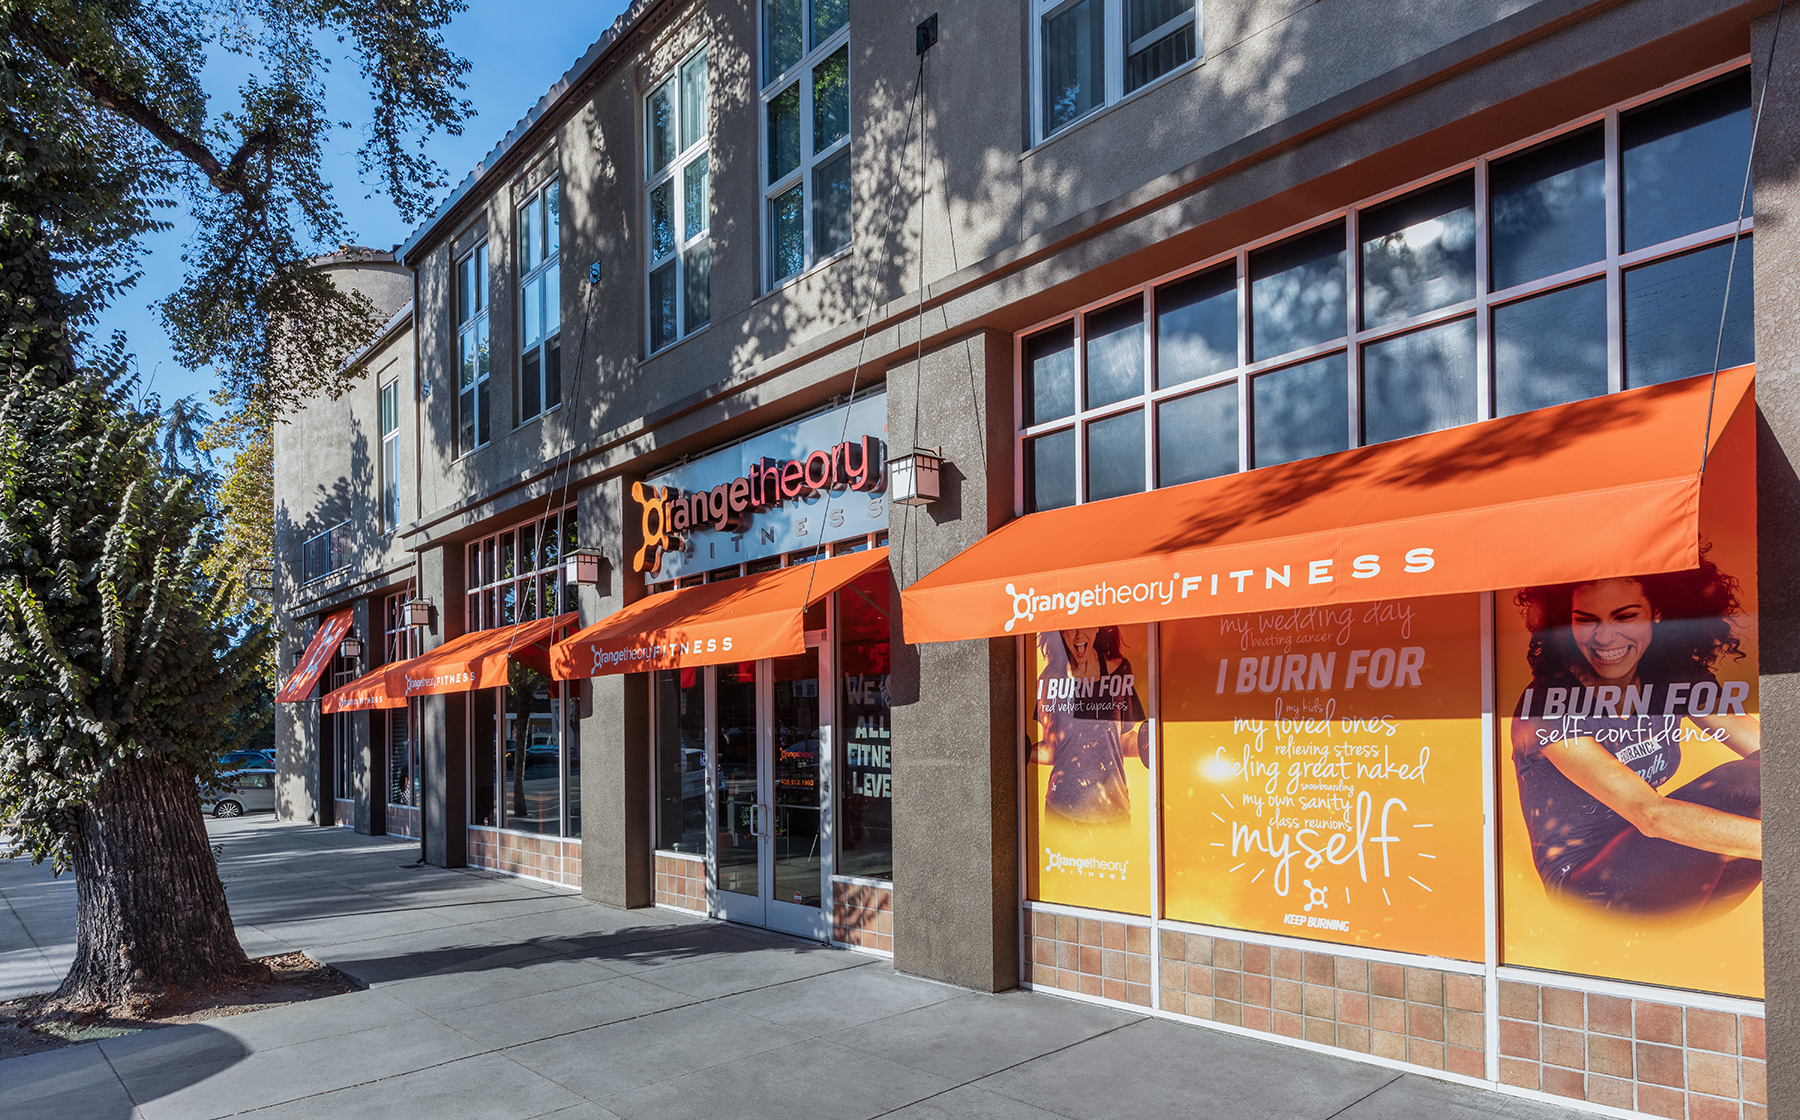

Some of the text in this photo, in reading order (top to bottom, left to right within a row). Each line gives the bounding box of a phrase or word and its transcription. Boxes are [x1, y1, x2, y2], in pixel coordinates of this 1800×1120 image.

[684, 498, 884, 564] FITNESS
[1181, 547, 1435, 599] FITNESS
[1220, 601, 1417, 651] my wedding day
[653, 637, 733, 659] FITNESS
[1251, 631, 1334, 653] beating cancer
[436, 671, 476, 687] FITNESS
[1216, 646, 1425, 694] I BURN FOR
[845, 672, 875, 705] WE
[1037, 674, 1136, 700] I BURN FOR
[1520, 680, 1750, 720] I BURN FOR
[1041, 695, 1129, 719] red velvet cupcakes
[1286, 698, 1324, 719] my kids
[855, 716, 890, 739] ALL
[1234, 698, 1400, 752] my loved ones
[1535, 713, 1731, 748] self-confidence
[1275, 735, 1381, 767] relieving stress
[1212, 744, 1431, 795] feeling great naked
[1300, 779, 1354, 798] snowboarding
[1242, 793, 1354, 824] my own sanity
[1269, 808, 1354, 832] class reunions
[1232, 790, 1408, 897] myself
[1061, 868, 1127, 881] FITNESS
[1283, 913, 1350, 932] KEEP BURNING
